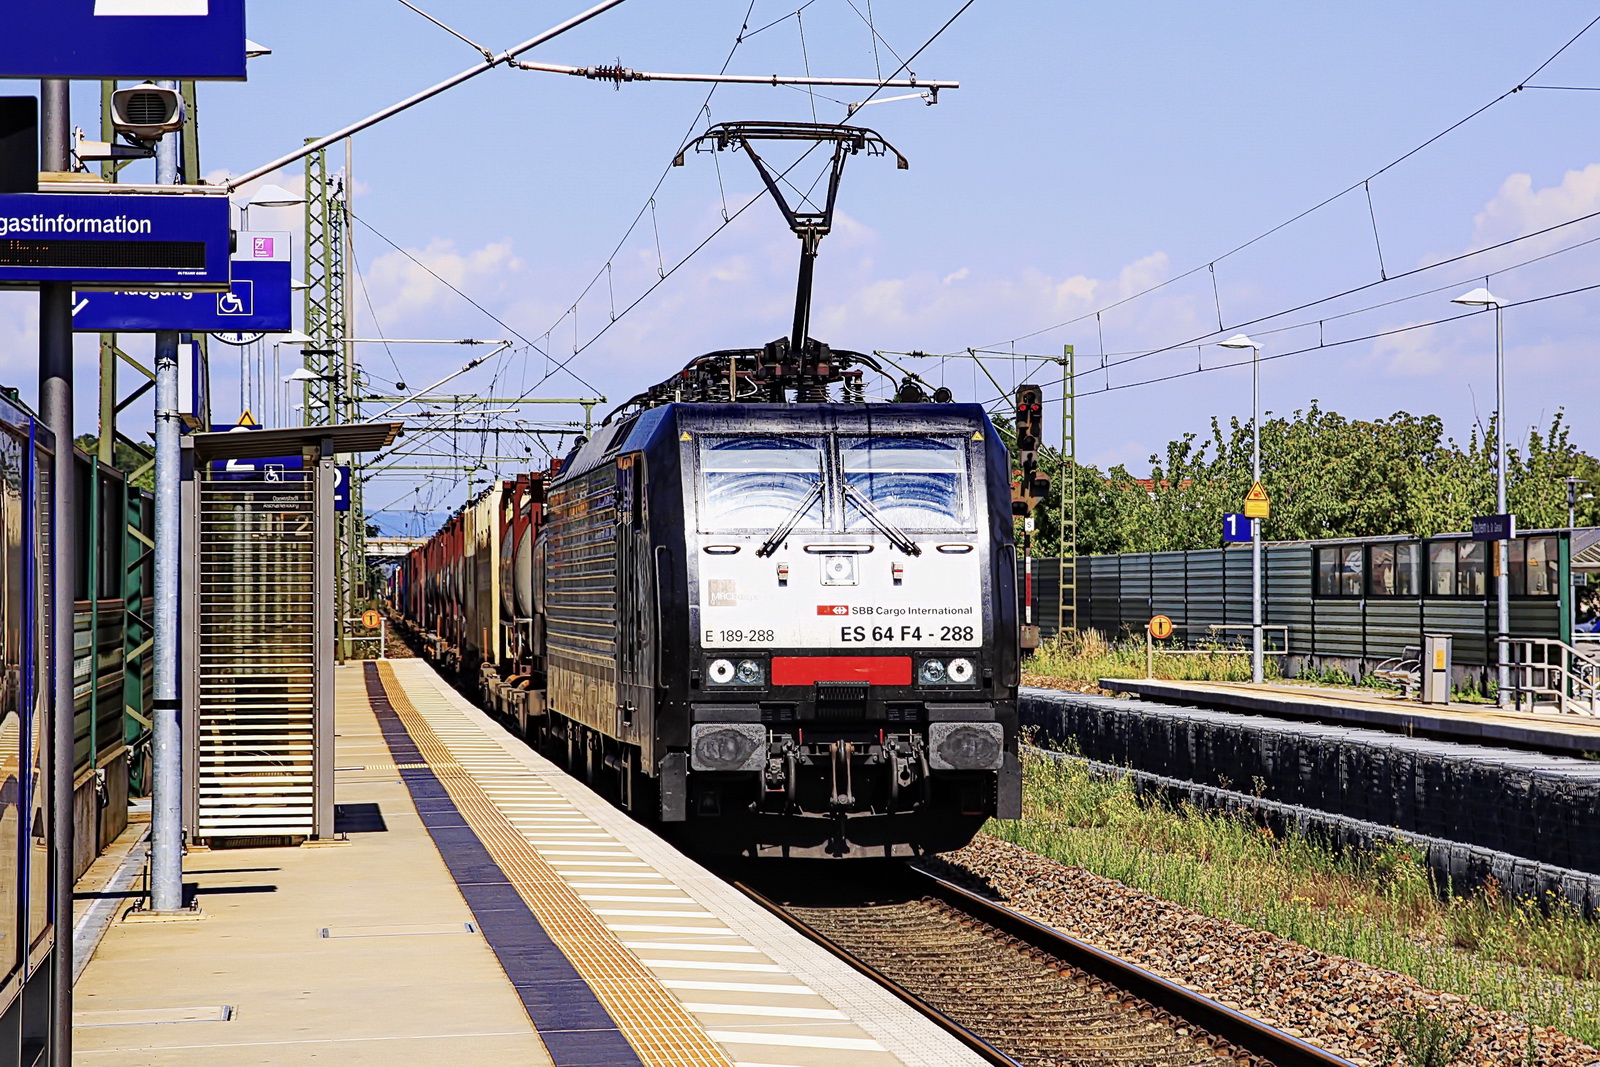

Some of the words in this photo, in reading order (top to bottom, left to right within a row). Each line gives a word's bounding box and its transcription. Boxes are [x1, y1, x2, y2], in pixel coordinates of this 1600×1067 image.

[1226, 514, 1236, 536] 1
[852, 607, 874, 615] SBB
[876, 607, 906, 617] Cargo
[908, 607, 973, 615] International
[705, 630, 714, 642] E
[719, 629, 775, 642] 189-288
[841, 626, 866, 642] ES
[872, 626, 894, 642] 64
[901, 626, 922, 641] F4
[940, 626, 974, 642] 288
